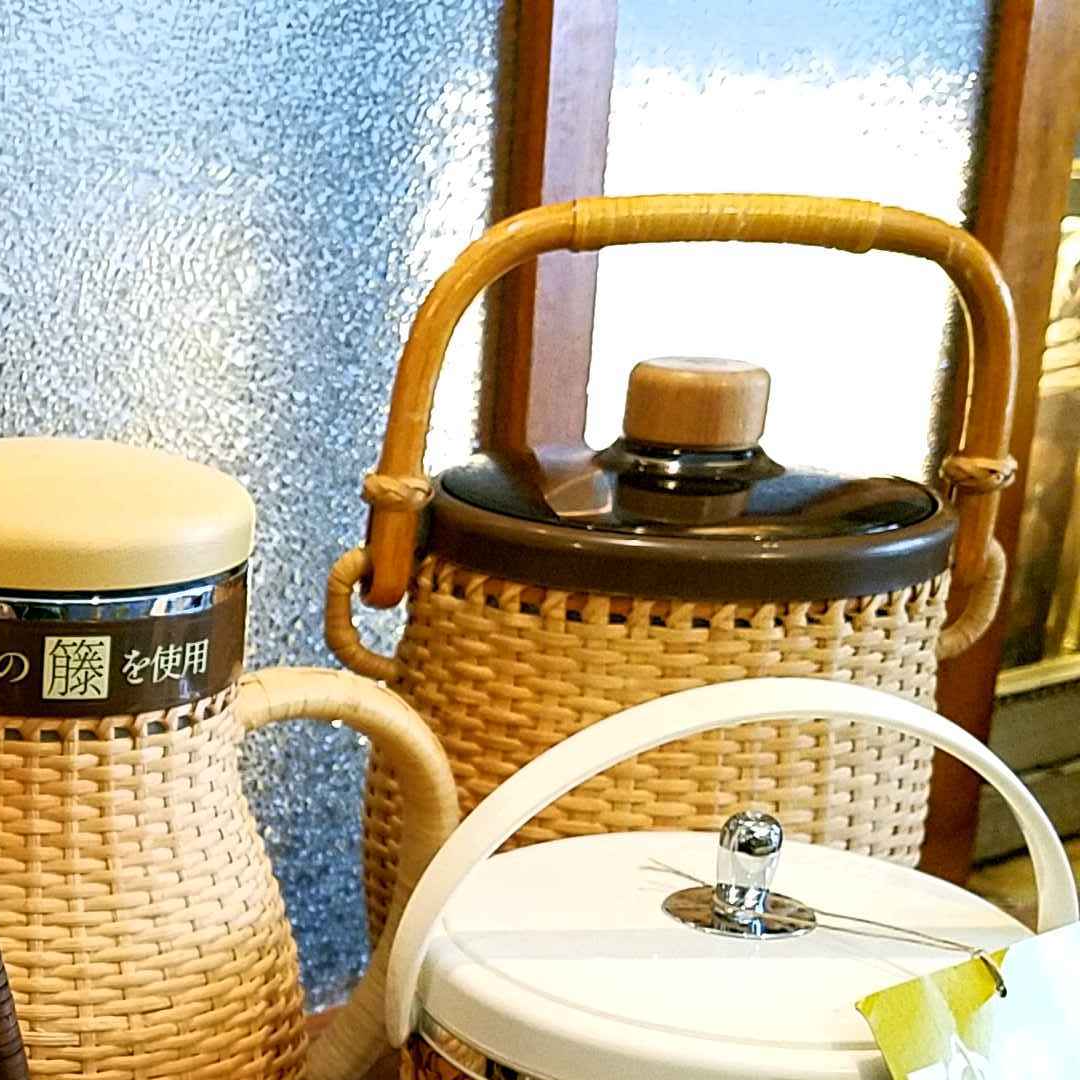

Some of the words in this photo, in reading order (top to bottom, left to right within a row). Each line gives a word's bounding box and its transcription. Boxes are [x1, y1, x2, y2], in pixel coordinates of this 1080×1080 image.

[48, 639, 105, 696] 籐
[122, 638, 209, 685] を使用
